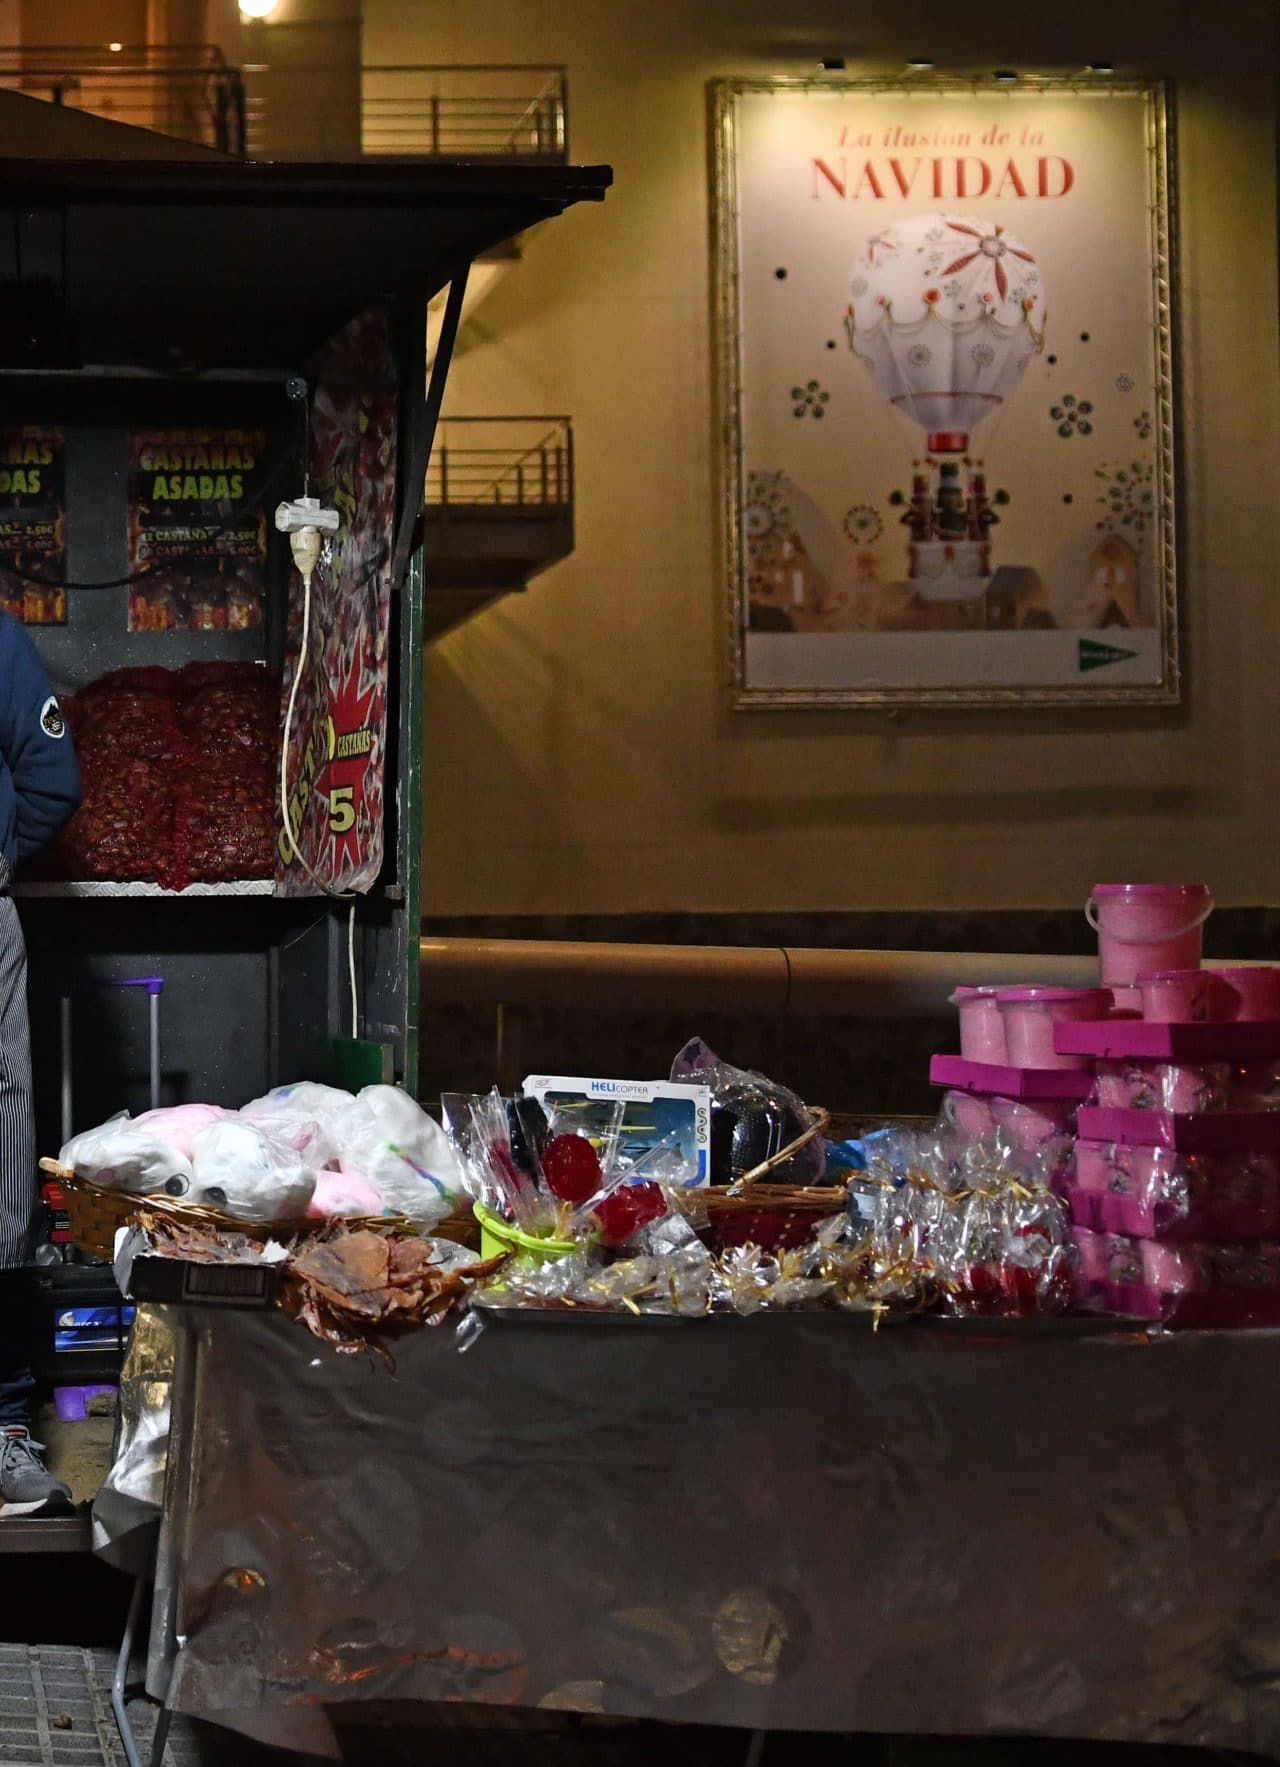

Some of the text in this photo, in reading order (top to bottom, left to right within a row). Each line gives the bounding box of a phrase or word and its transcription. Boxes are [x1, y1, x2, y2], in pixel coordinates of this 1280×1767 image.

[982, 123, 1011, 147] de
[1020, 125, 1046, 147] la
[811, 156, 1075, 199] NAVIDAD
[152, 474, 243, 500] ASADAS
[329, 787, 356, 832] 5
